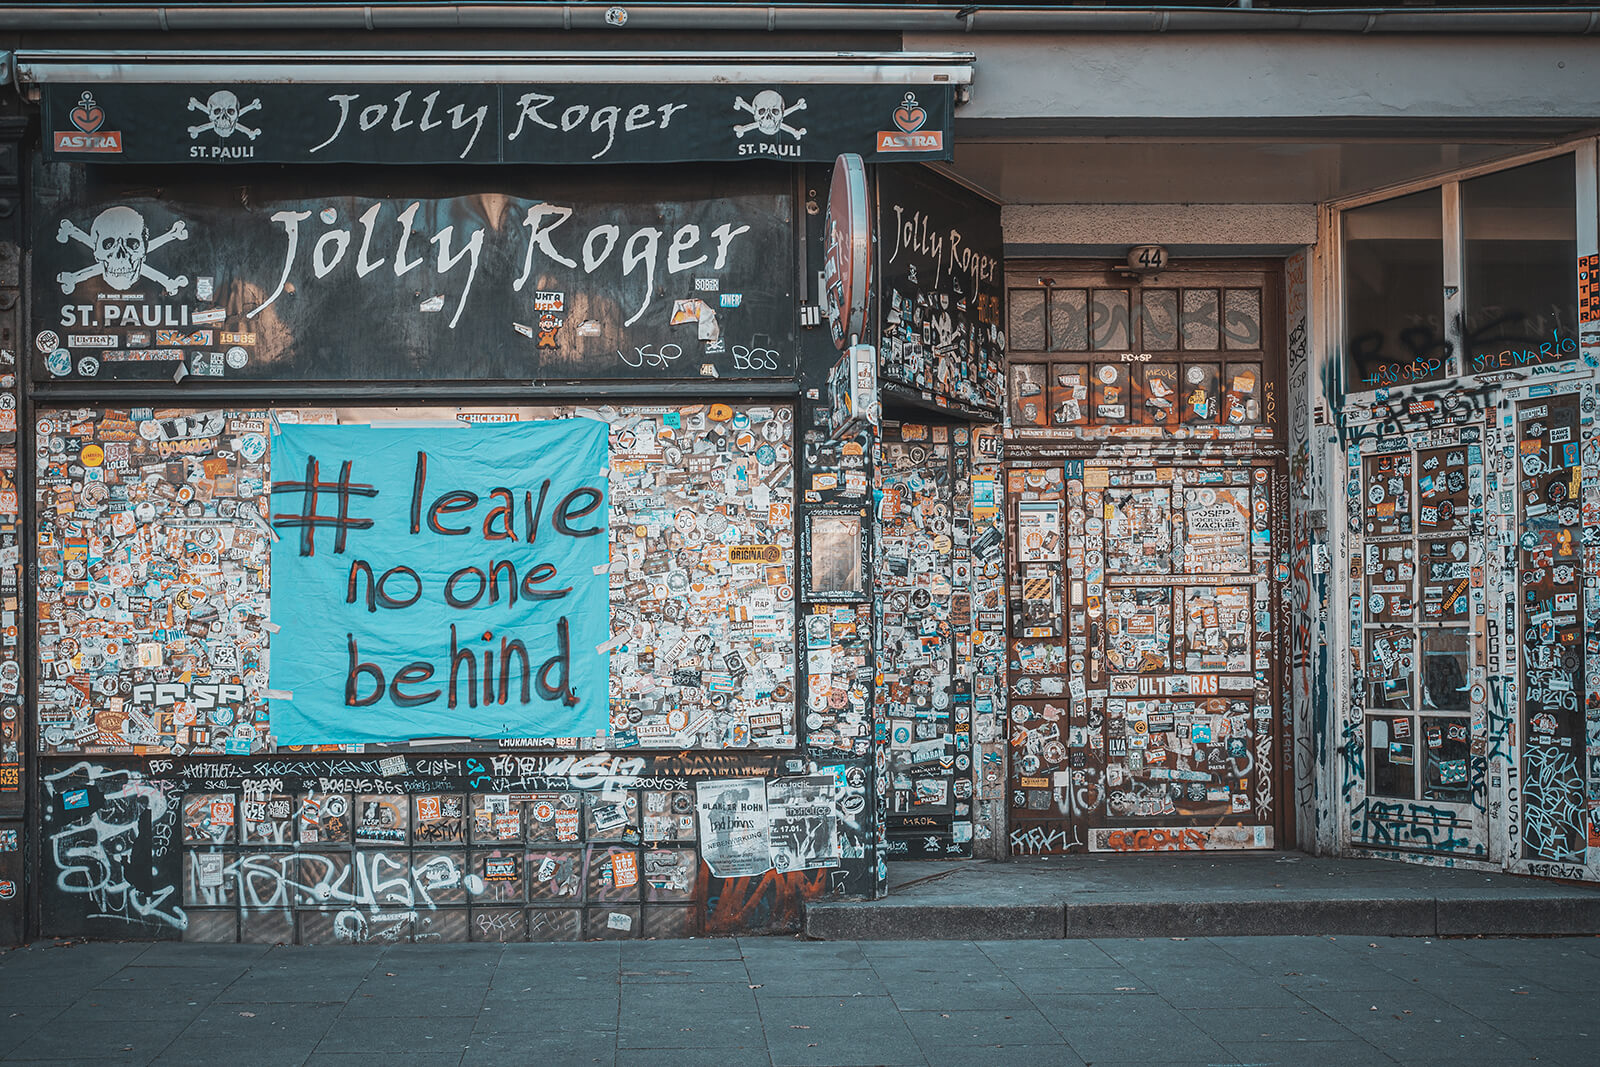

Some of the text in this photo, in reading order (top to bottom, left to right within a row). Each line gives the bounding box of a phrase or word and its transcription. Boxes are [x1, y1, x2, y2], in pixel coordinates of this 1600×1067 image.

[310, 90, 687, 159] Jolly Roger
[59, 136, 118, 149] ASTRA
[738, 143, 801, 157] ST. PAULI
[881, 136, 938, 148] ASTRA
[190, 146, 254, 158] ST. PAULI
[889, 204, 998, 304] Jolly Roger
[1138, 248, 1162, 267] 44
[247, 202, 750, 329] Jolly Roger
[60, 304, 188, 326] ST. PAULI
[617, 344, 682, 368] USP
[732, 345, 780, 370] BGS
[1551, 428, 1569, 436] RAWS
[1066, 461, 1082, 477] 44
[410, 451, 604, 544] leave
[1421, 507, 1438, 516] FCK
[1421, 515, 1438, 523] NZS
[346, 560, 573, 613] no one
[1556, 595, 1576, 604] CNT
[345, 616, 581, 710] behind
[1139, 676, 1218, 695] ULT RAS
[0, 768, 18, 776] FCK
[0, 776, 18, 785] NZS
[780, 825, 802, 833] 17.01.
[903, 817, 937, 825] MROK
[707, 831, 762, 850] NEBENWIRKUNG
